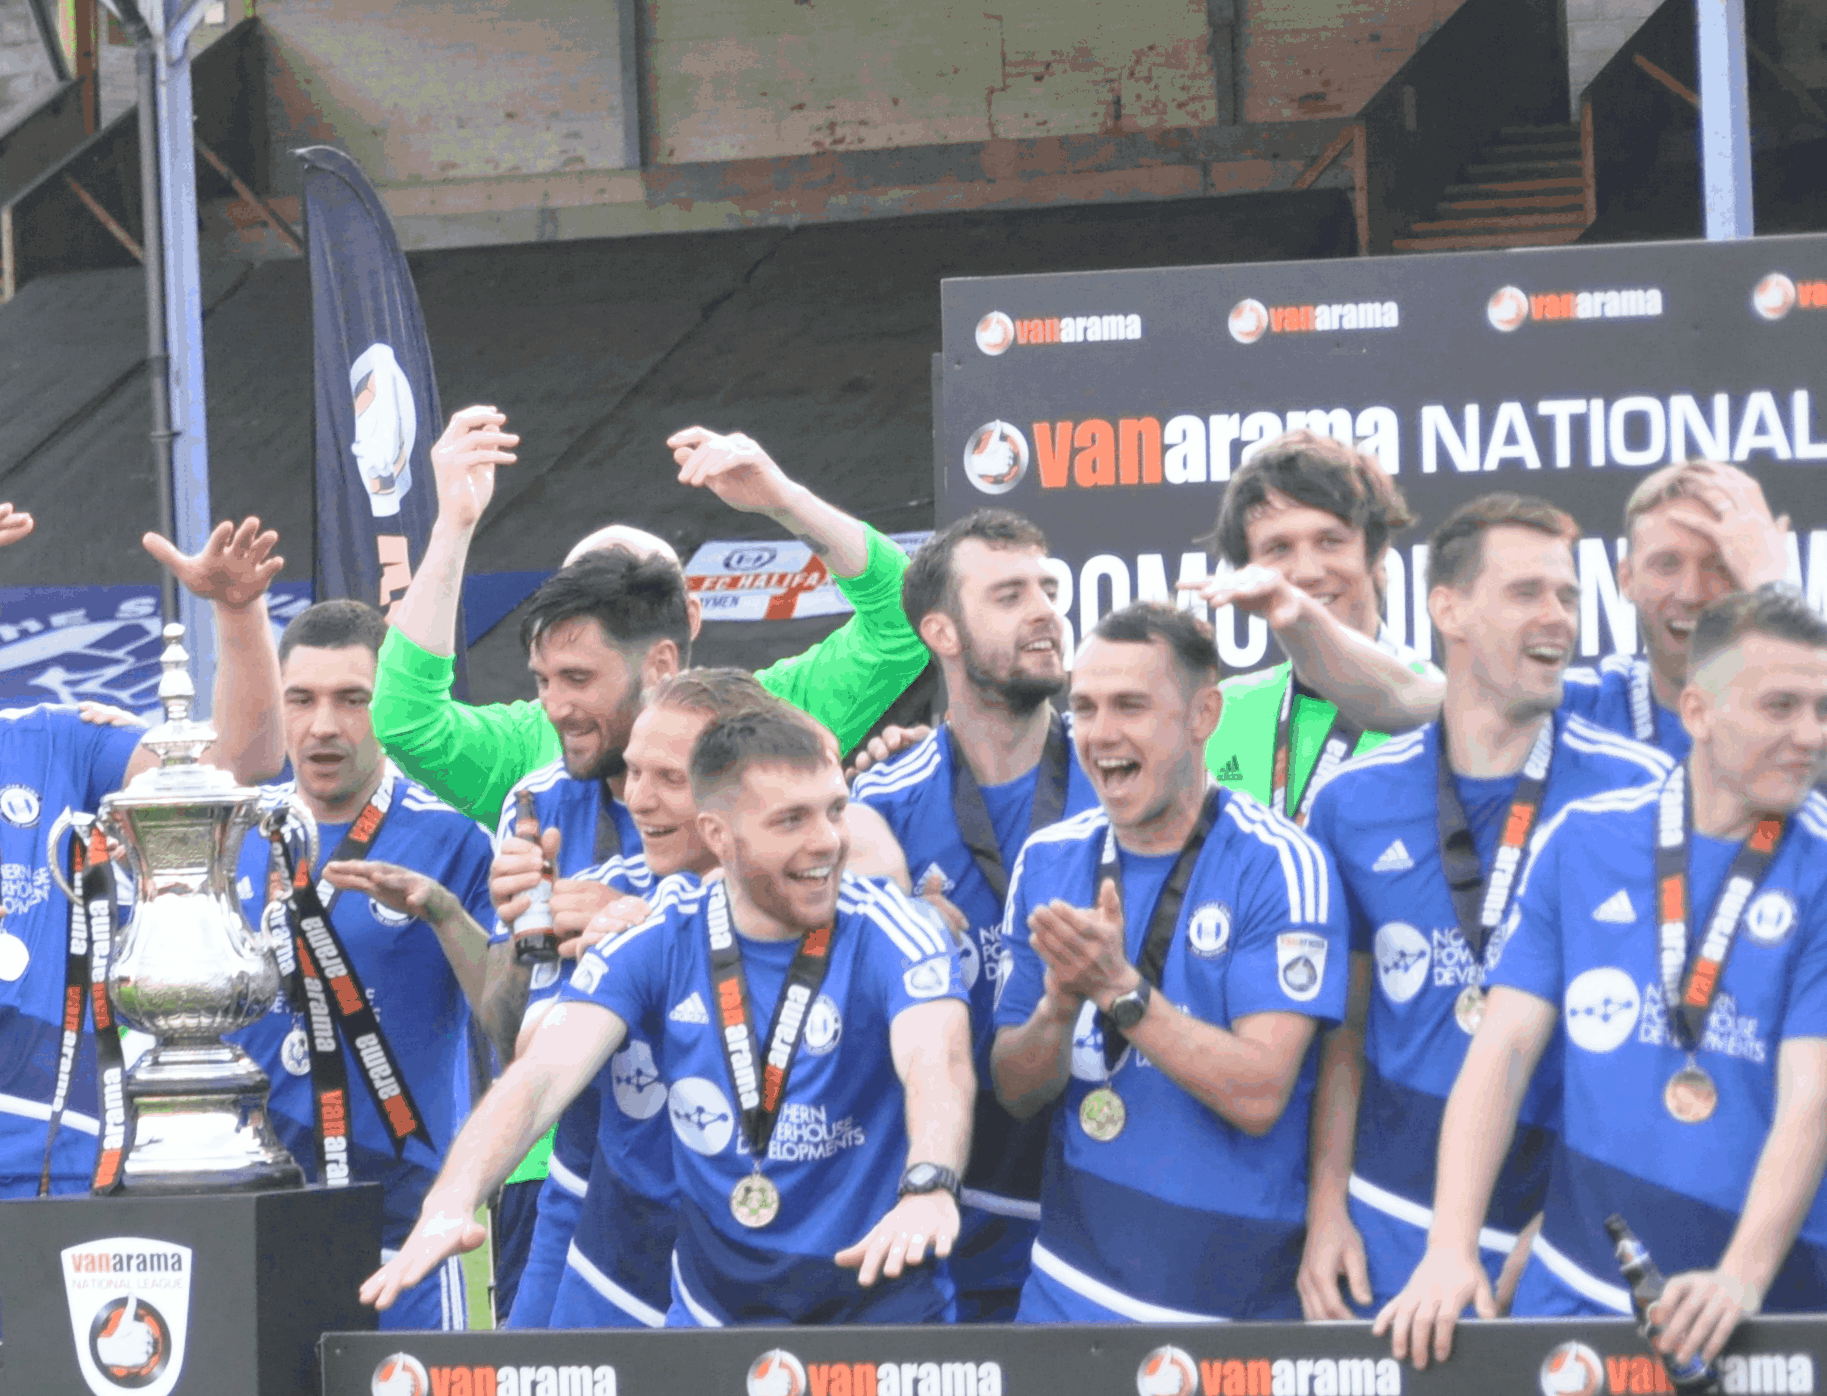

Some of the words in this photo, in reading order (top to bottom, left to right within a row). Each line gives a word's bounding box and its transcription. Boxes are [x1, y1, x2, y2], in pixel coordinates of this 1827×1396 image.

[1270, 298, 1399, 333] vanarama
[1530, 284, 1663, 320] vanarama
[1016, 309, 1142, 347] vanarama
[1420, 388, 1827, 474] NATIONAL
[737, 570, 821, 589] HALIFA
[718, 976, 760, 1110] vanarama
[71, 1252, 183, 1274] vanarama
[1605, 1354, 1814, 1396] vaama
